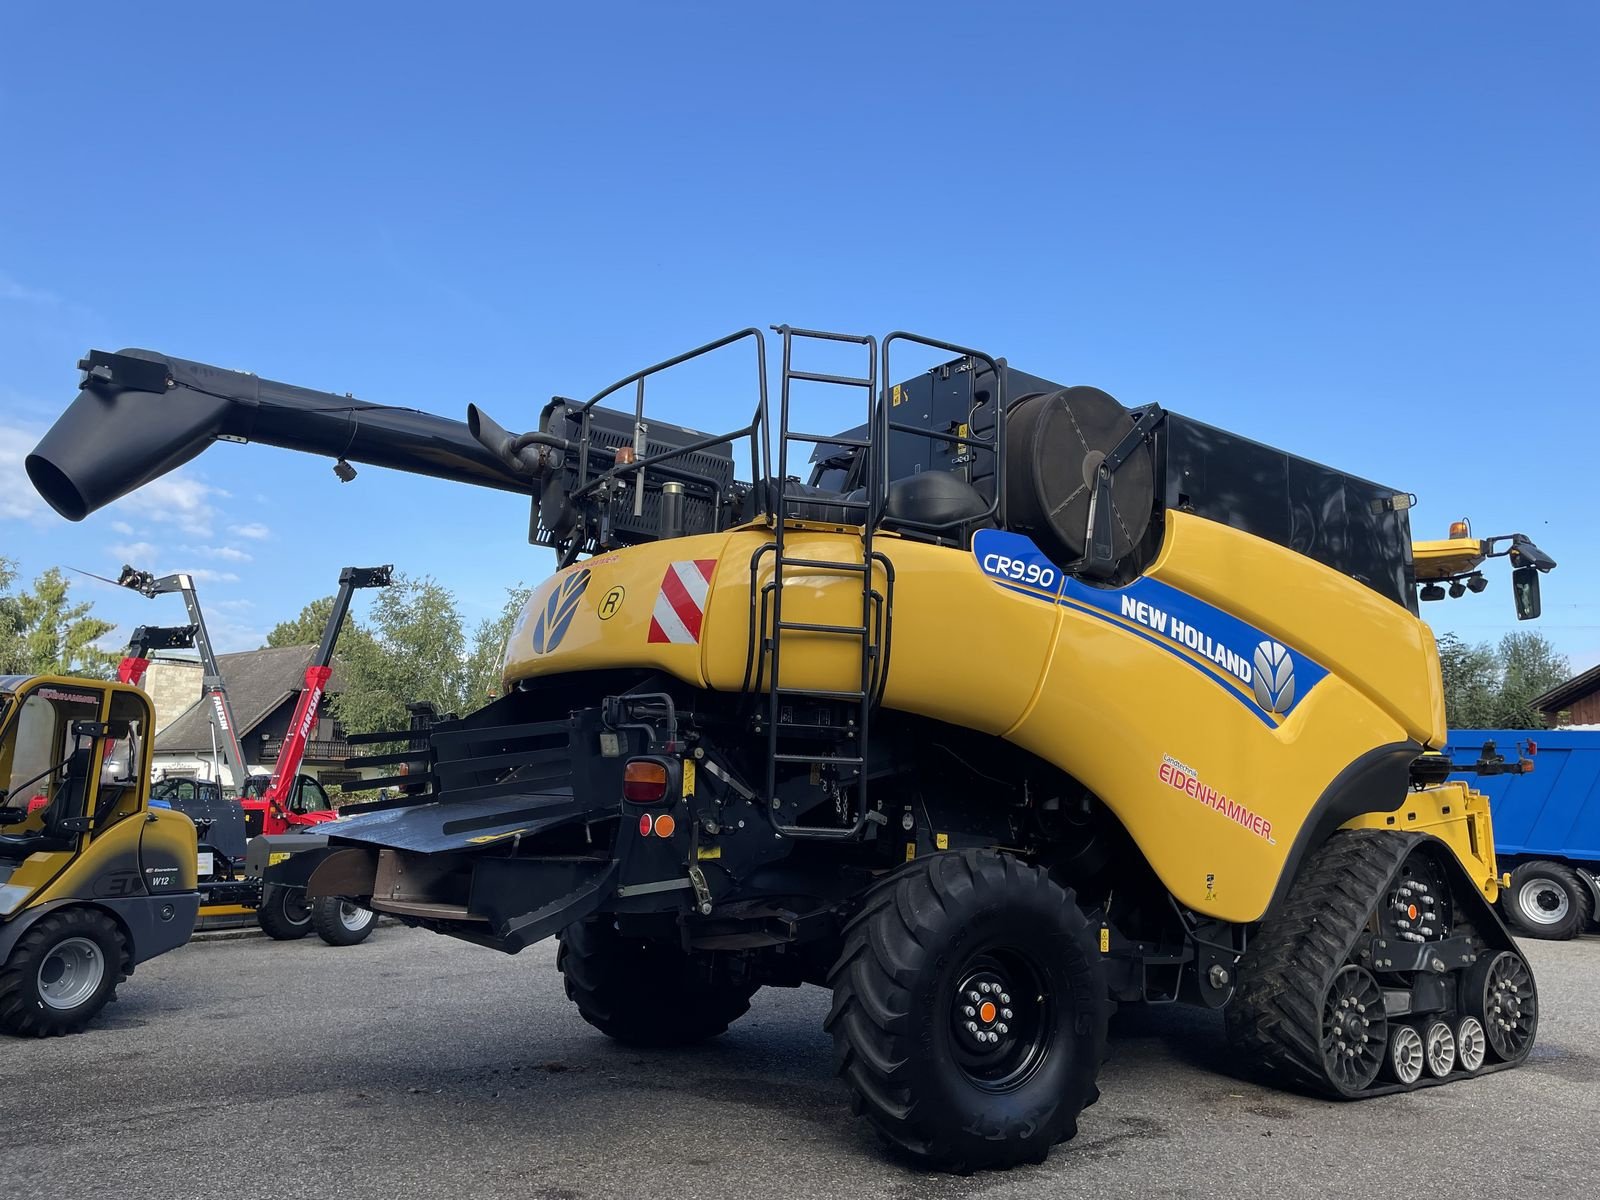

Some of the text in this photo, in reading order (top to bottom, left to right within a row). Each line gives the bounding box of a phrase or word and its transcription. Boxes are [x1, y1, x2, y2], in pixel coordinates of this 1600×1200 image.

[983, 553, 1055, 587] CR9.90
[602, 592, 620, 613] R
[1121, 595, 1252, 684] NEW HOLLAND
[212, 696, 229, 731] FARESIN
[300, 686, 322, 739] FARESIN
[1163, 752, 1198, 777] Landtechnik
[1159, 763, 1272, 841] EIDENHAMMER
